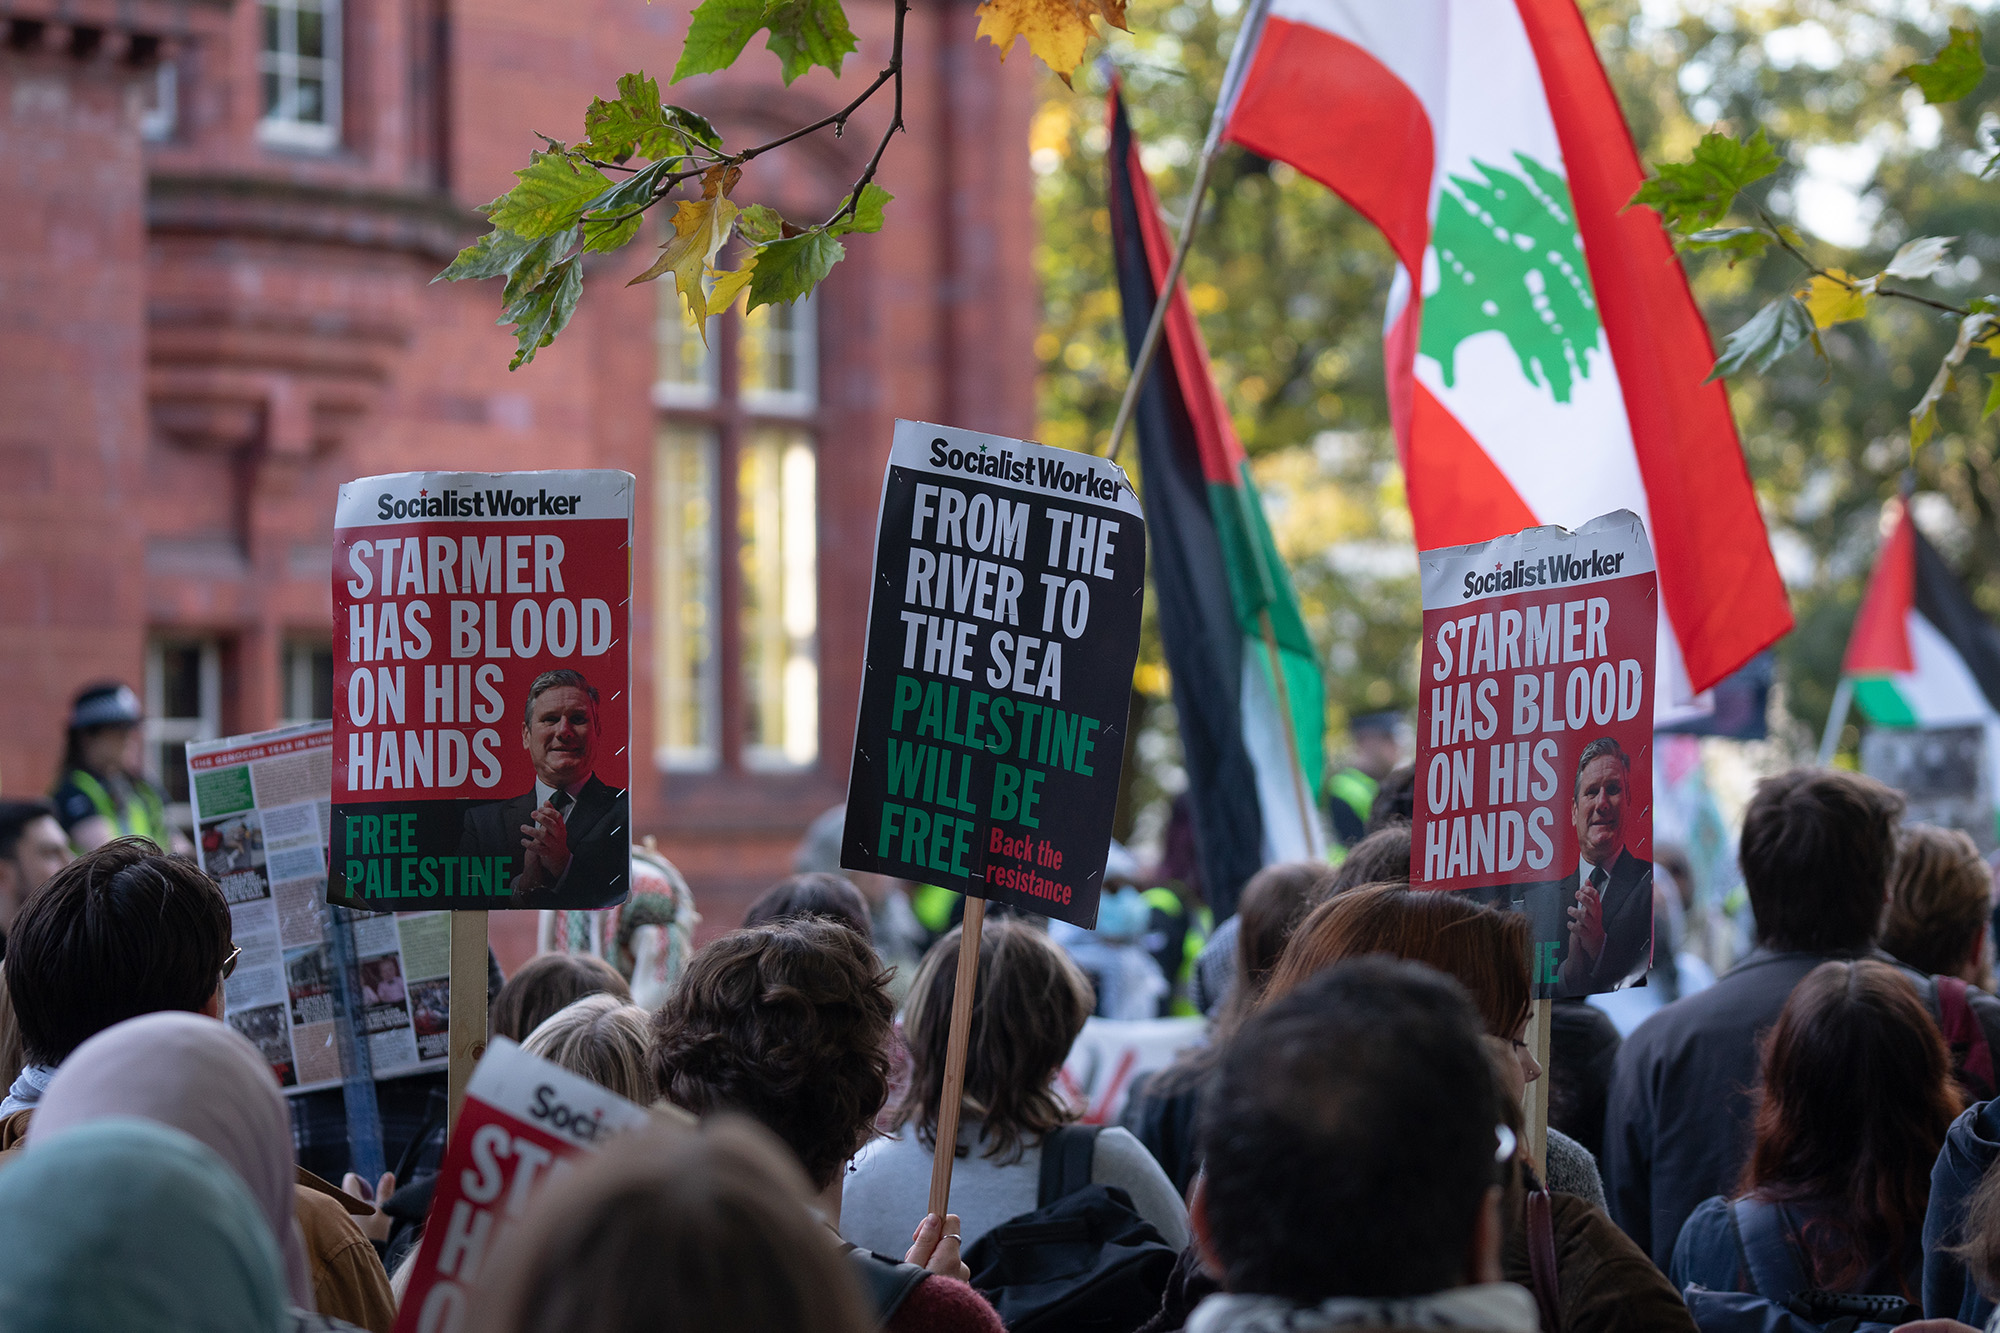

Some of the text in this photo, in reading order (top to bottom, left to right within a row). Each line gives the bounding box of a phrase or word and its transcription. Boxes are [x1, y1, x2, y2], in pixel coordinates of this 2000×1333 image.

[346, 535, 565, 599] STARMER
[911, 483, 1120, 581] FROM THE
[349, 597, 612, 663] HAS BLOOD
[904, 547, 1090, 639] RIVER TO
[900, 610, 1062, 702] THE SEA
[1432, 596, 1610, 682] STARMER
[347, 663, 505, 728] ON HIS
[891, 674, 1101, 777] PALESTINE
[1430, 657, 1644, 749] HAS BLOOD
[194, 757, 212, 768] THE
[214, 747, 265, 764] GENOCIDE
[267, 741, 293, 754] YEAR
[294, 738, 306, 749] IN
[347, 728, 502, 792] HANDS
[887, 737, 1046, 829] WILL BE
[1427, 737, 1559, 815] ON HIS
[345, 812, 419, 856] FREE
[877, 801, 975, 879] FREE
[988, 827, 1063, 871] Back the
[1423, 805, 1554, 883] HANDS
[345, 856, 513, 900] PALESTINE
[985, 863, 1073, 906] resistance
